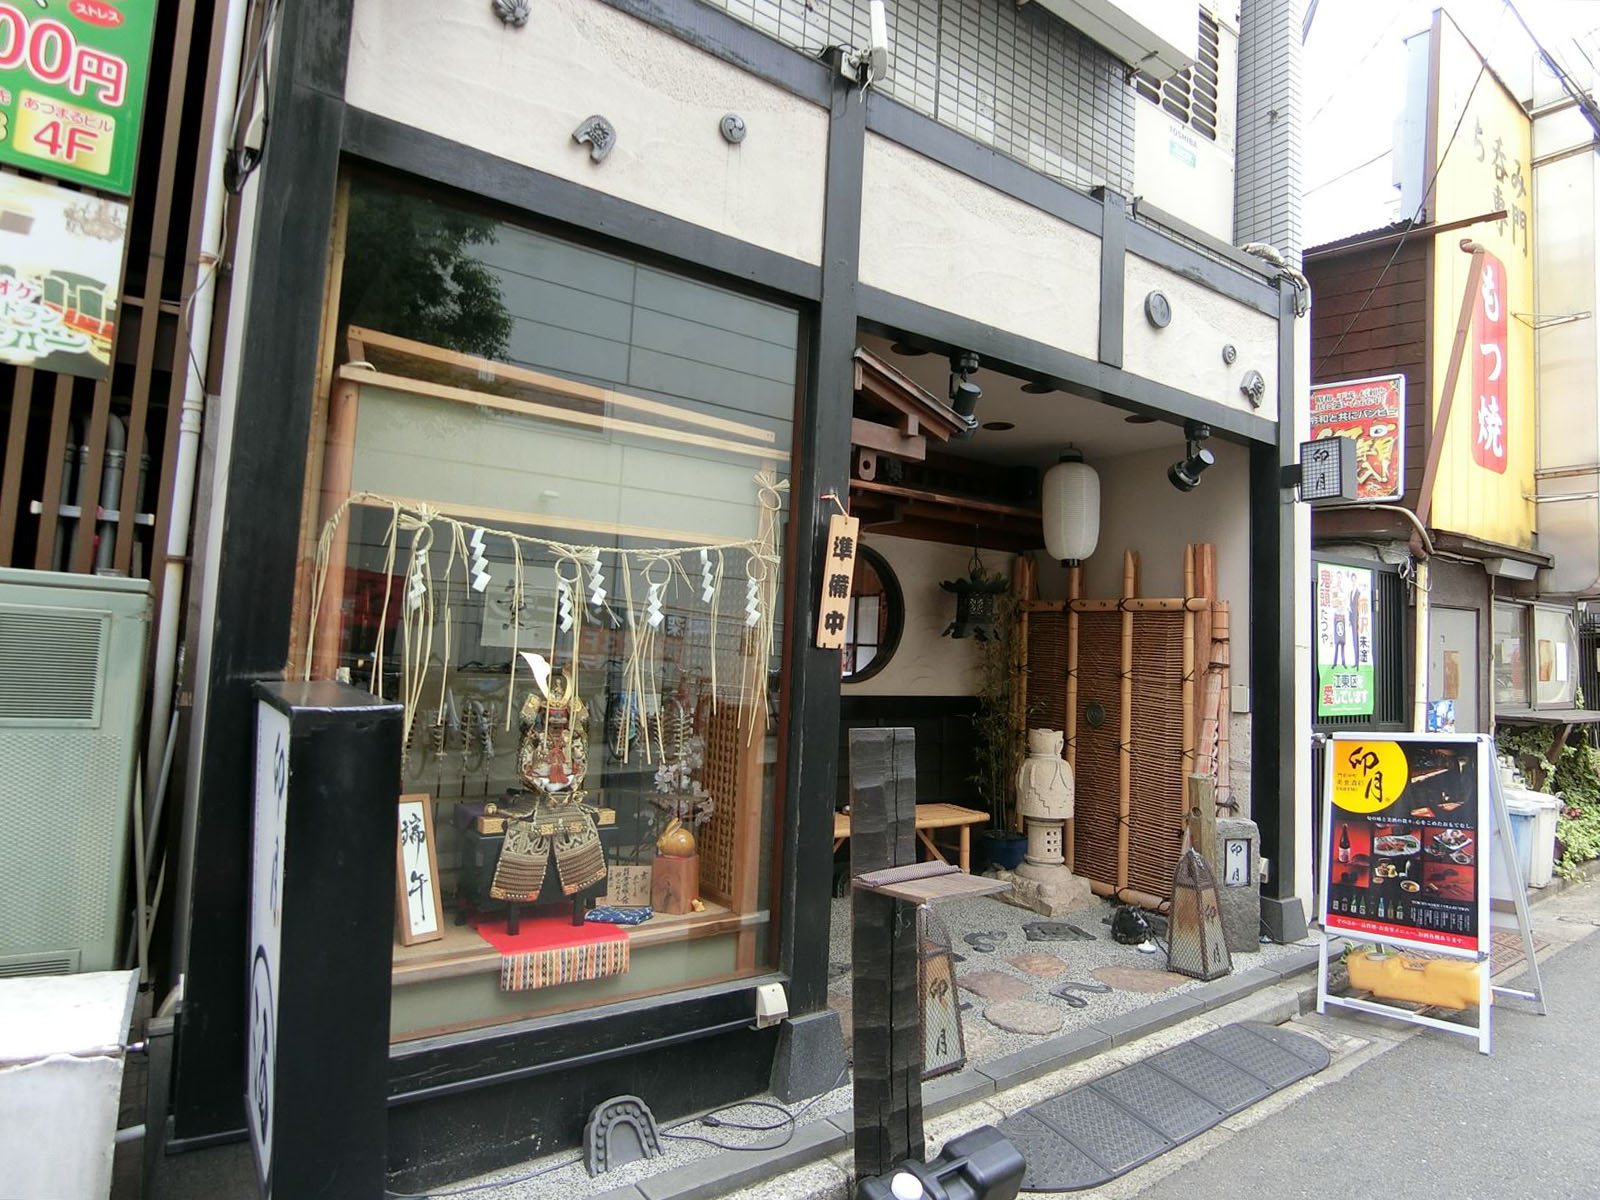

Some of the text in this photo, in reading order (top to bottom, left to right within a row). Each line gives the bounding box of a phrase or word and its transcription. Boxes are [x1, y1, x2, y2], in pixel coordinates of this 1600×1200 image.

[76, 2, 121, 24] ストレス
[24, 97, 113, 132] あつまるビル
[33, 120, 98, 160] 4F
[1476, 263, 1504, 459] もつ焼
[1312, 448, 1330, 490] 卯月
[824, 535, 854, 636] 準備中
[1348, 746, 1384, 803] 卯月
[269, 731, 286, 912] 卯月
[1230, 842, 1243, 882] 卯月
[1204, 904, 1222, 964] 卯月
[929, 976, 949, 1057] 卯月
